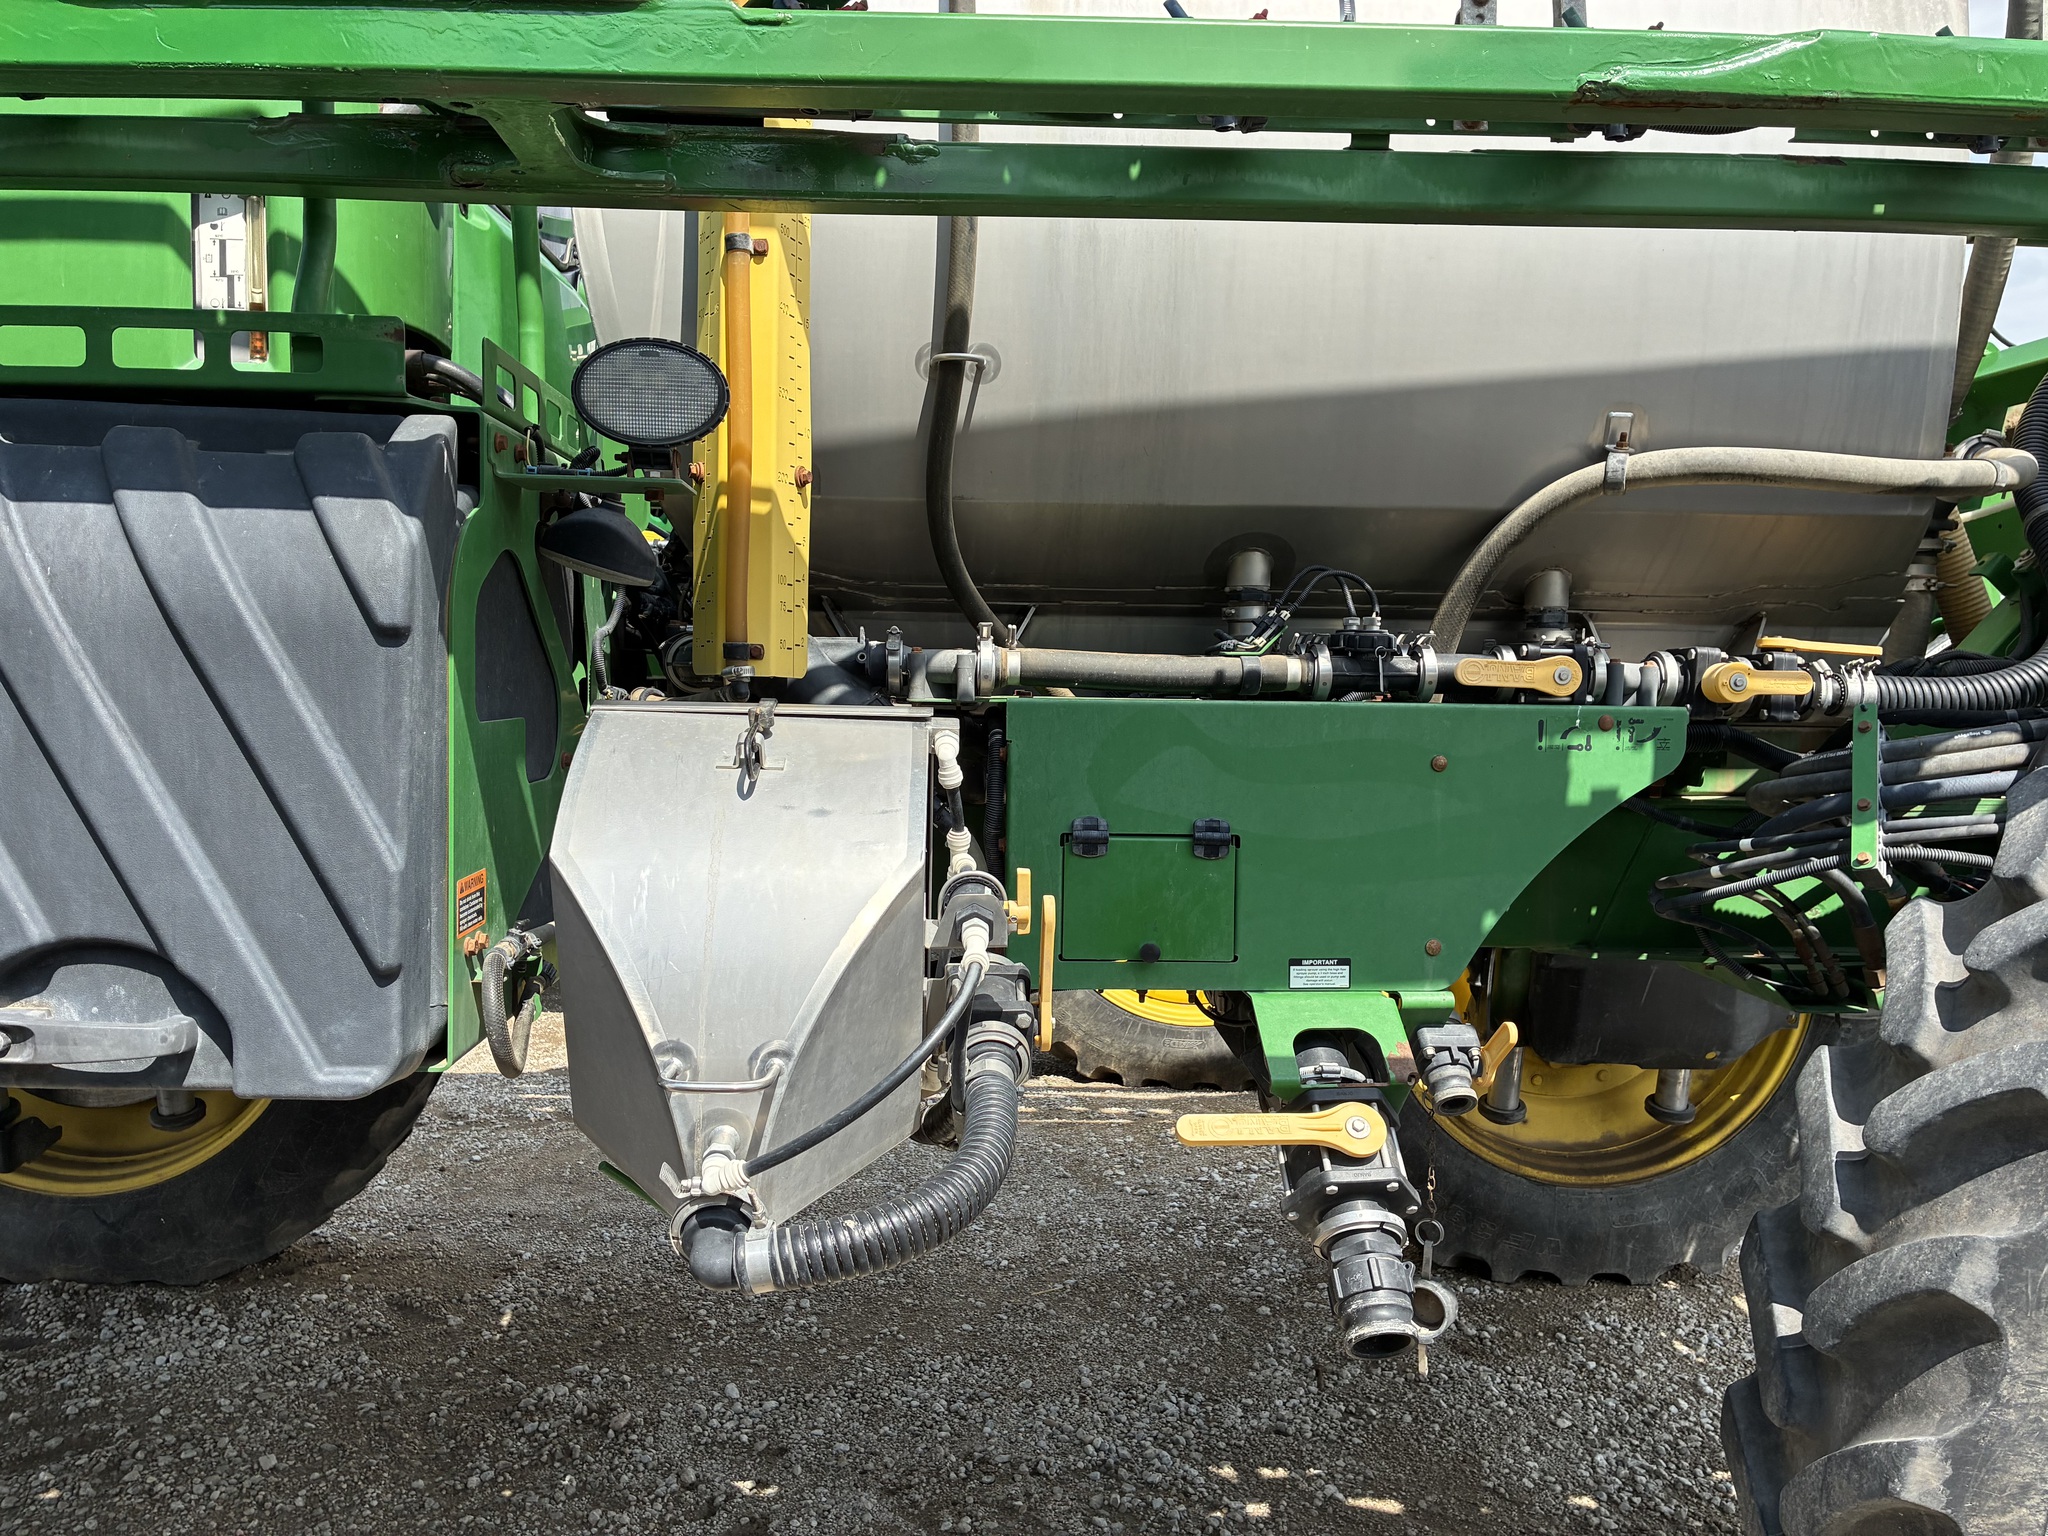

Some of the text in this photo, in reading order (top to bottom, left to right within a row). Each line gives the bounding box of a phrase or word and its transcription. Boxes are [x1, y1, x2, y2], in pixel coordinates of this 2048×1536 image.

[781, 223, 790, 238] 500
[779, 302, 788, 315] 400
[804, 318, 810, 329] 15
[778, 472, 788, 484] 200
[778, 574, 786, 586] 100
[780, 600, 786, 612] 75
[780, 638, 786, 650] 50
[464, 874, 484, 890] WARNING
